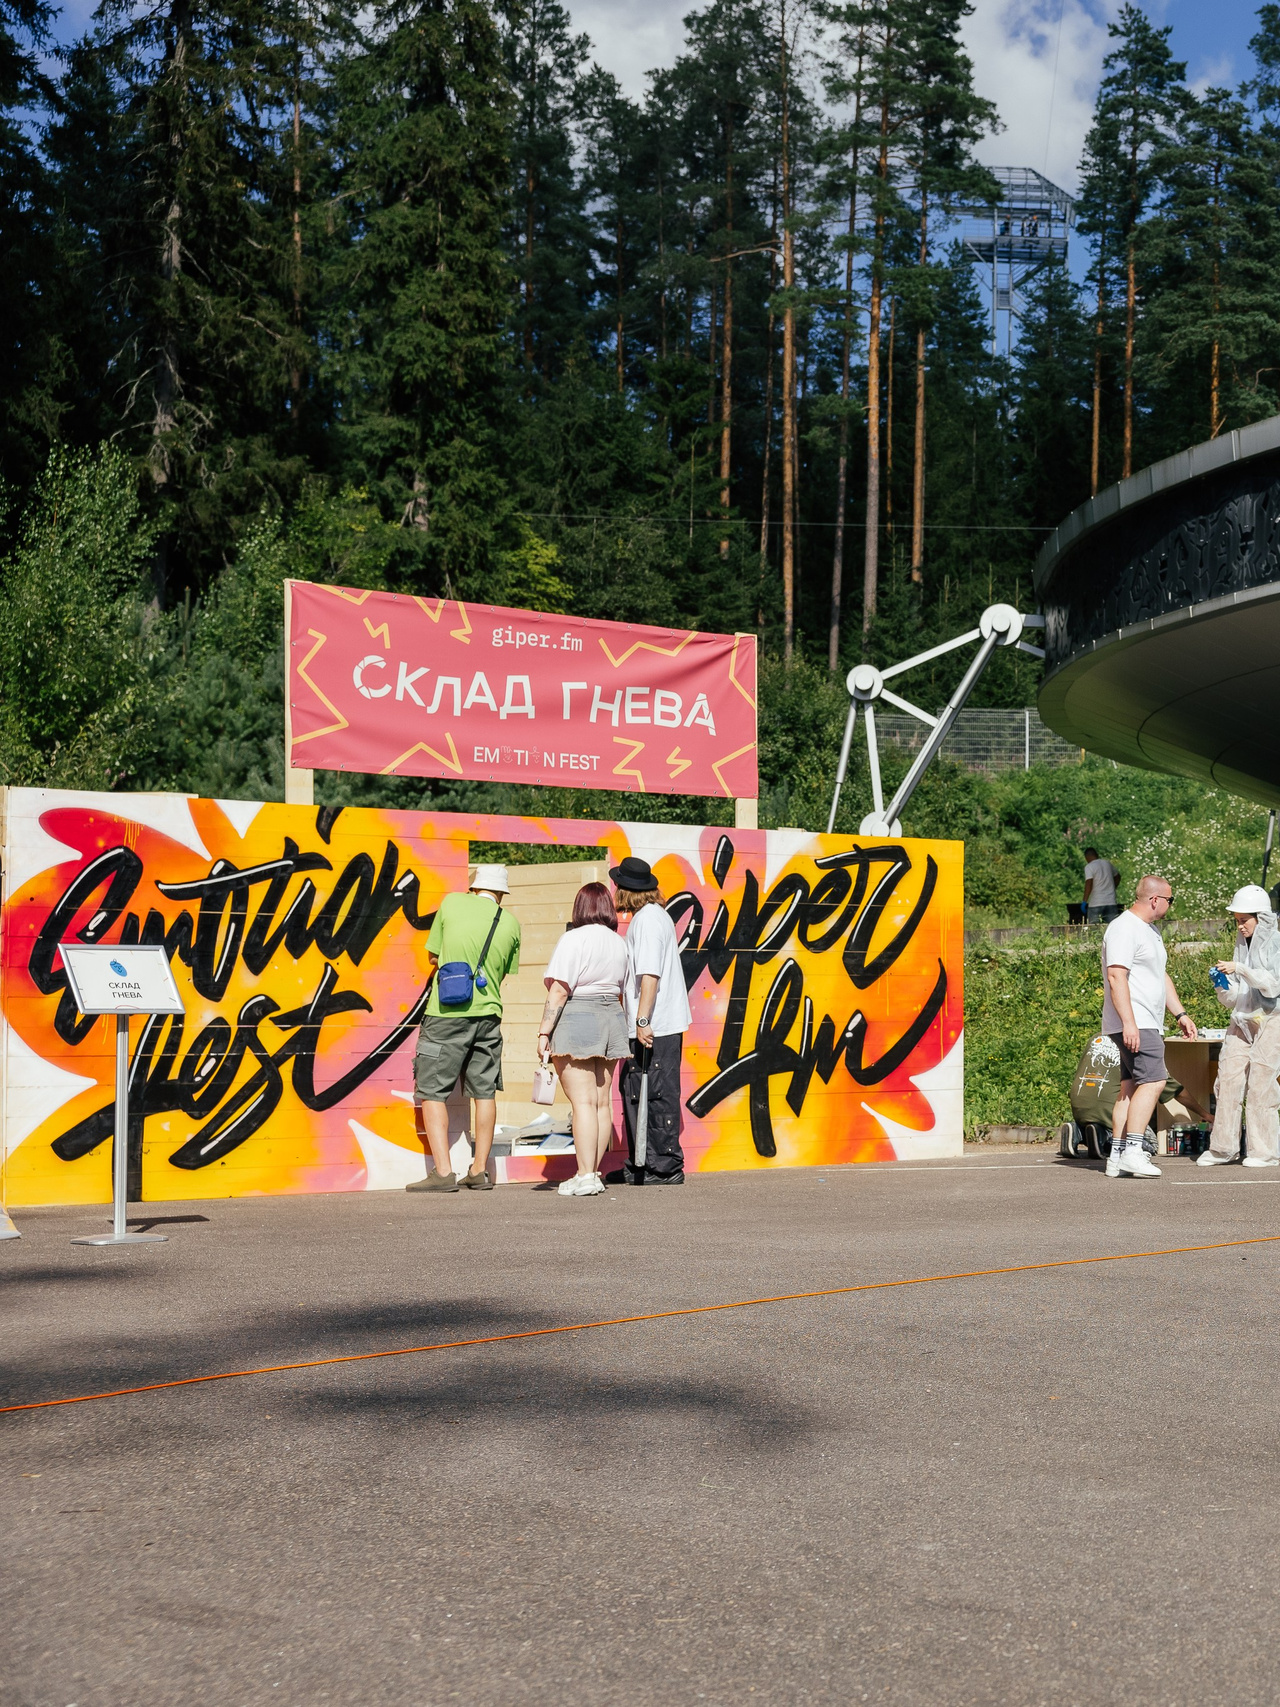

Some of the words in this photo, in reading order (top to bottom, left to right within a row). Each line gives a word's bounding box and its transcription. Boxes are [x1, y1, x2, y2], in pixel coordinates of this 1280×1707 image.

[491, 625, 583, 652] giper.fm
[352, 654, 536, 720] СКЛАД
[561, 680, 717, 737] ГНЕВА
[559, 752, 601, 771] FEST
[108, 982, 141, 990] СКЛАД
[685, 956, 948, 1158] fm
